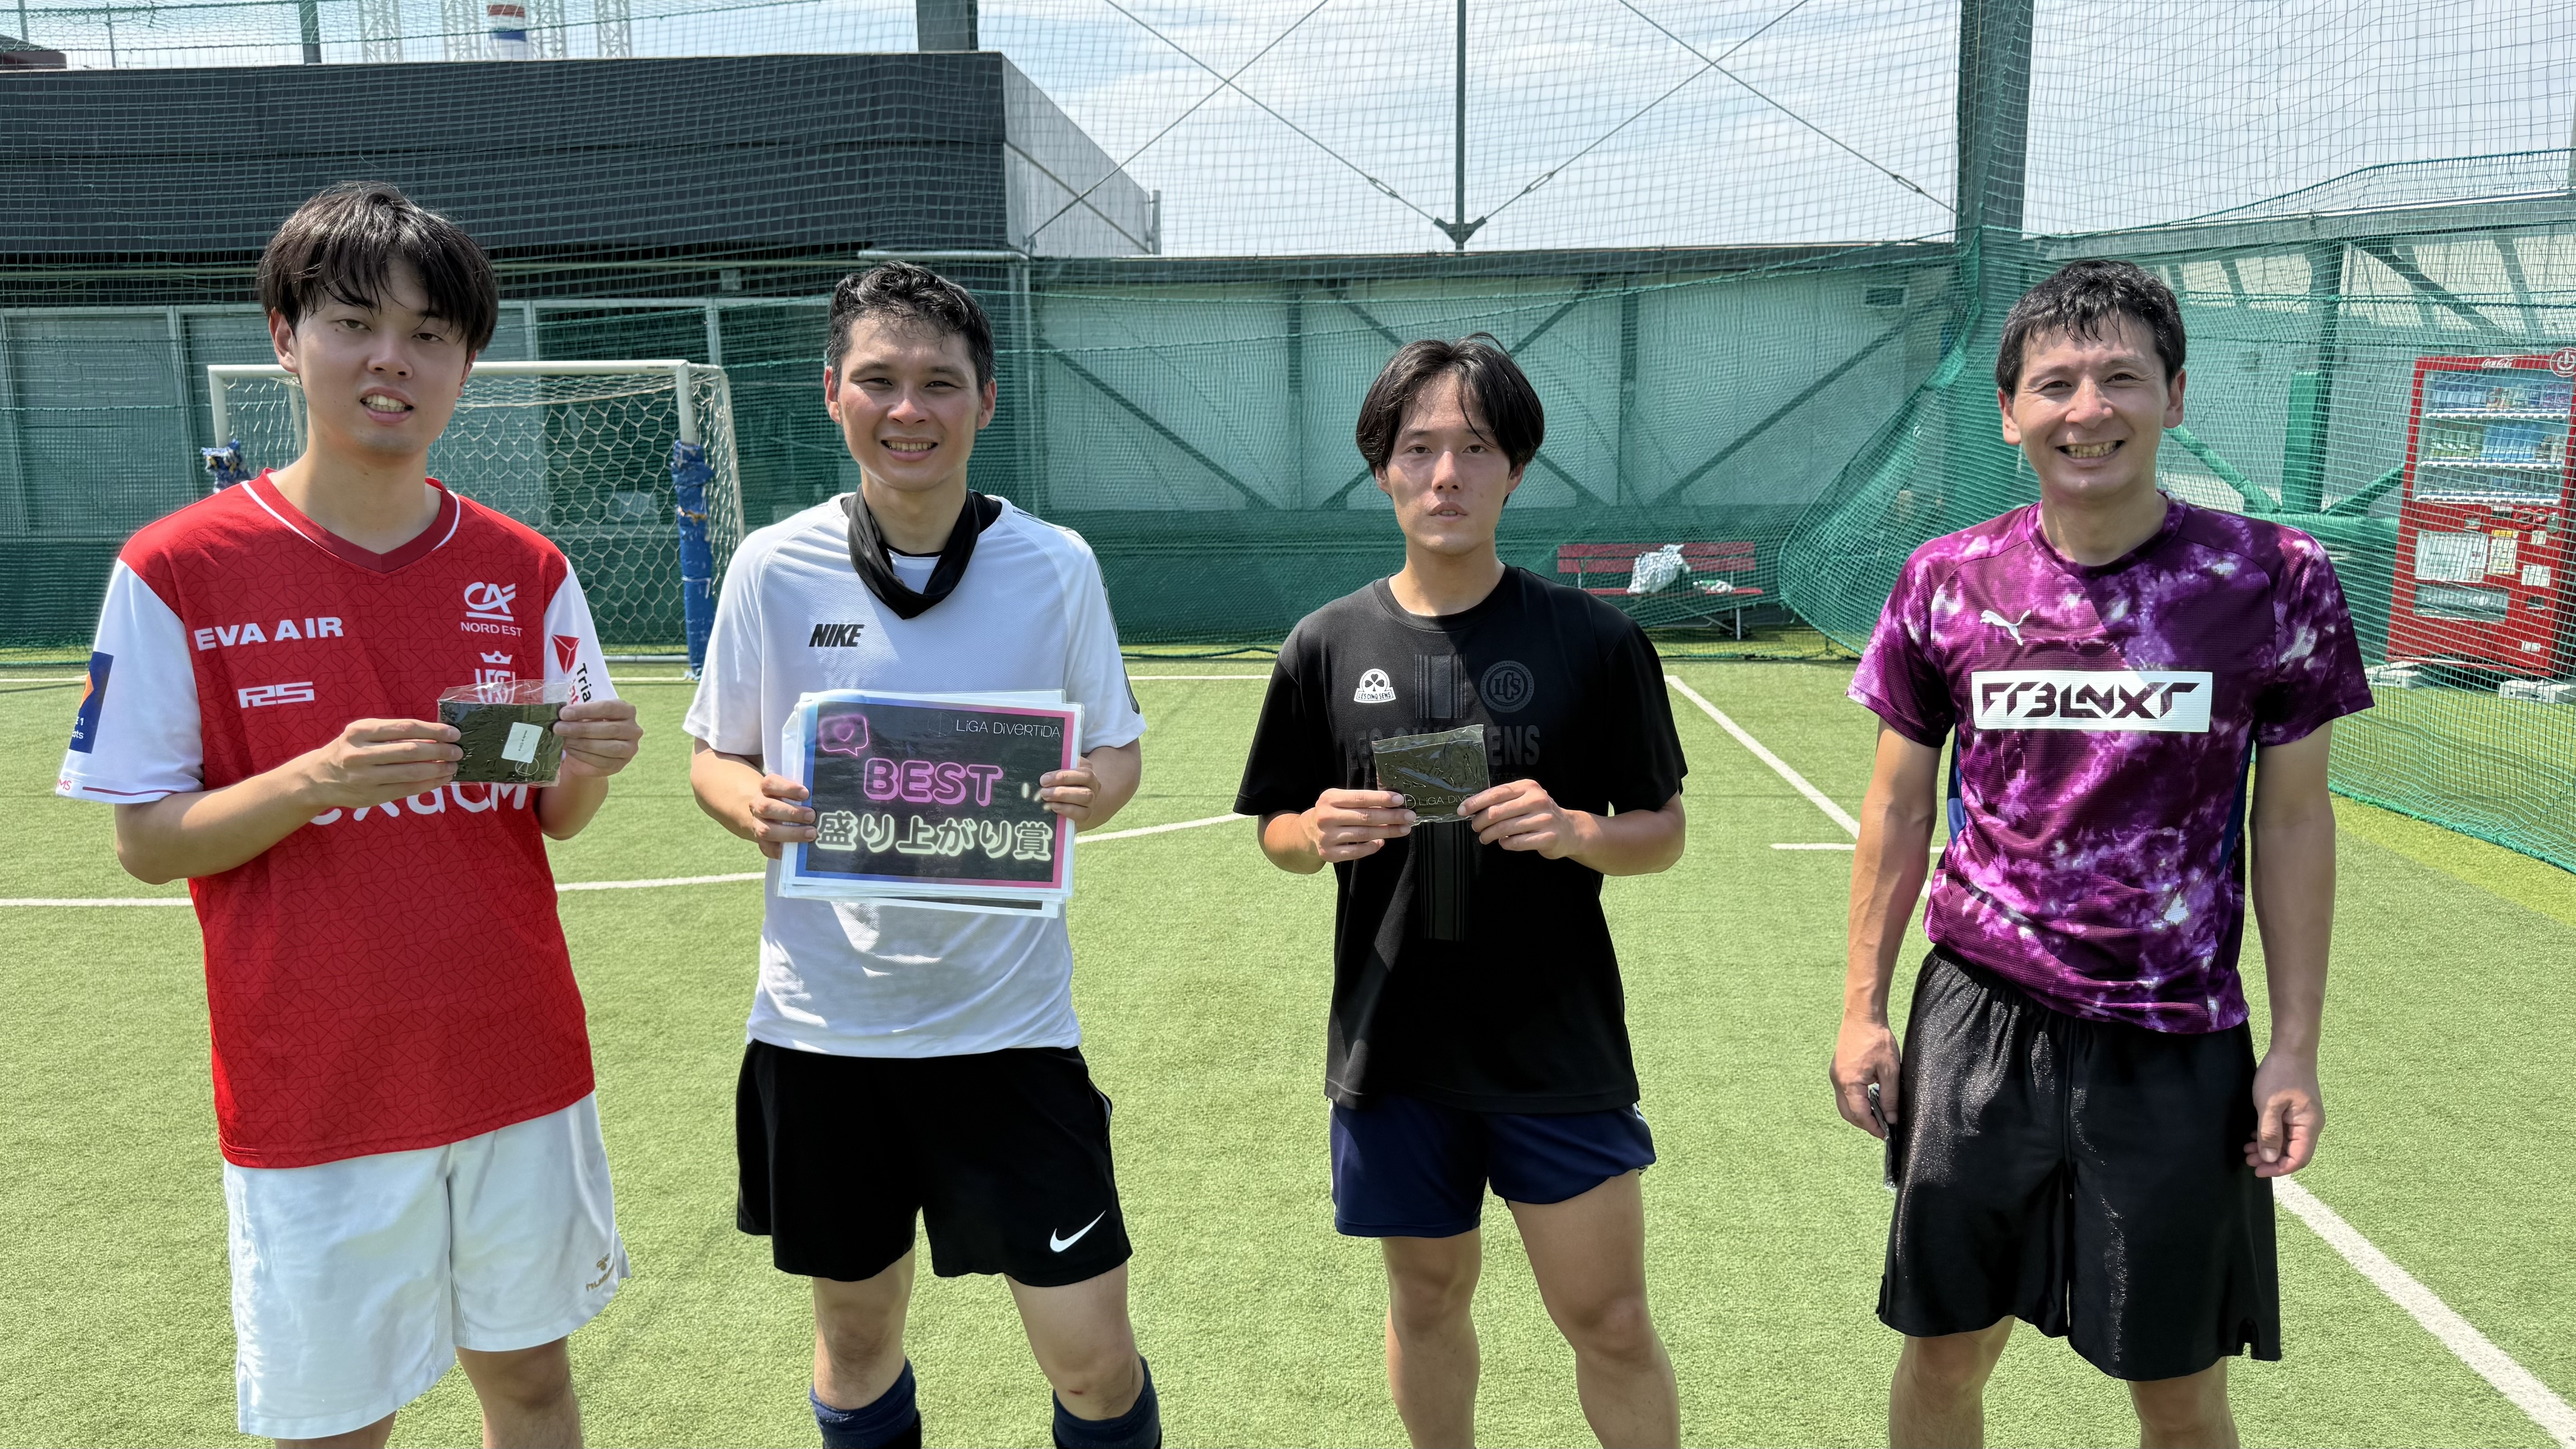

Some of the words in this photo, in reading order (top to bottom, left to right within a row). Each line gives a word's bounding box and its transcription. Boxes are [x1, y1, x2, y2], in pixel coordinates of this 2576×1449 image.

[194, 623, 267, 651] EVA
[274, 617, 344, 641] AIR
[460, 621, 500, 634] NORD
[502, 625, 522, 637] EST
[809, 624, 865, 647] NIKE
[577, 662, 592, 703] Tria
[1486, 725, 1540, 765] ENS
[864, 758, 1003, 806] BEST
[815, 810, 1053, 861] 盛り上がり賞
